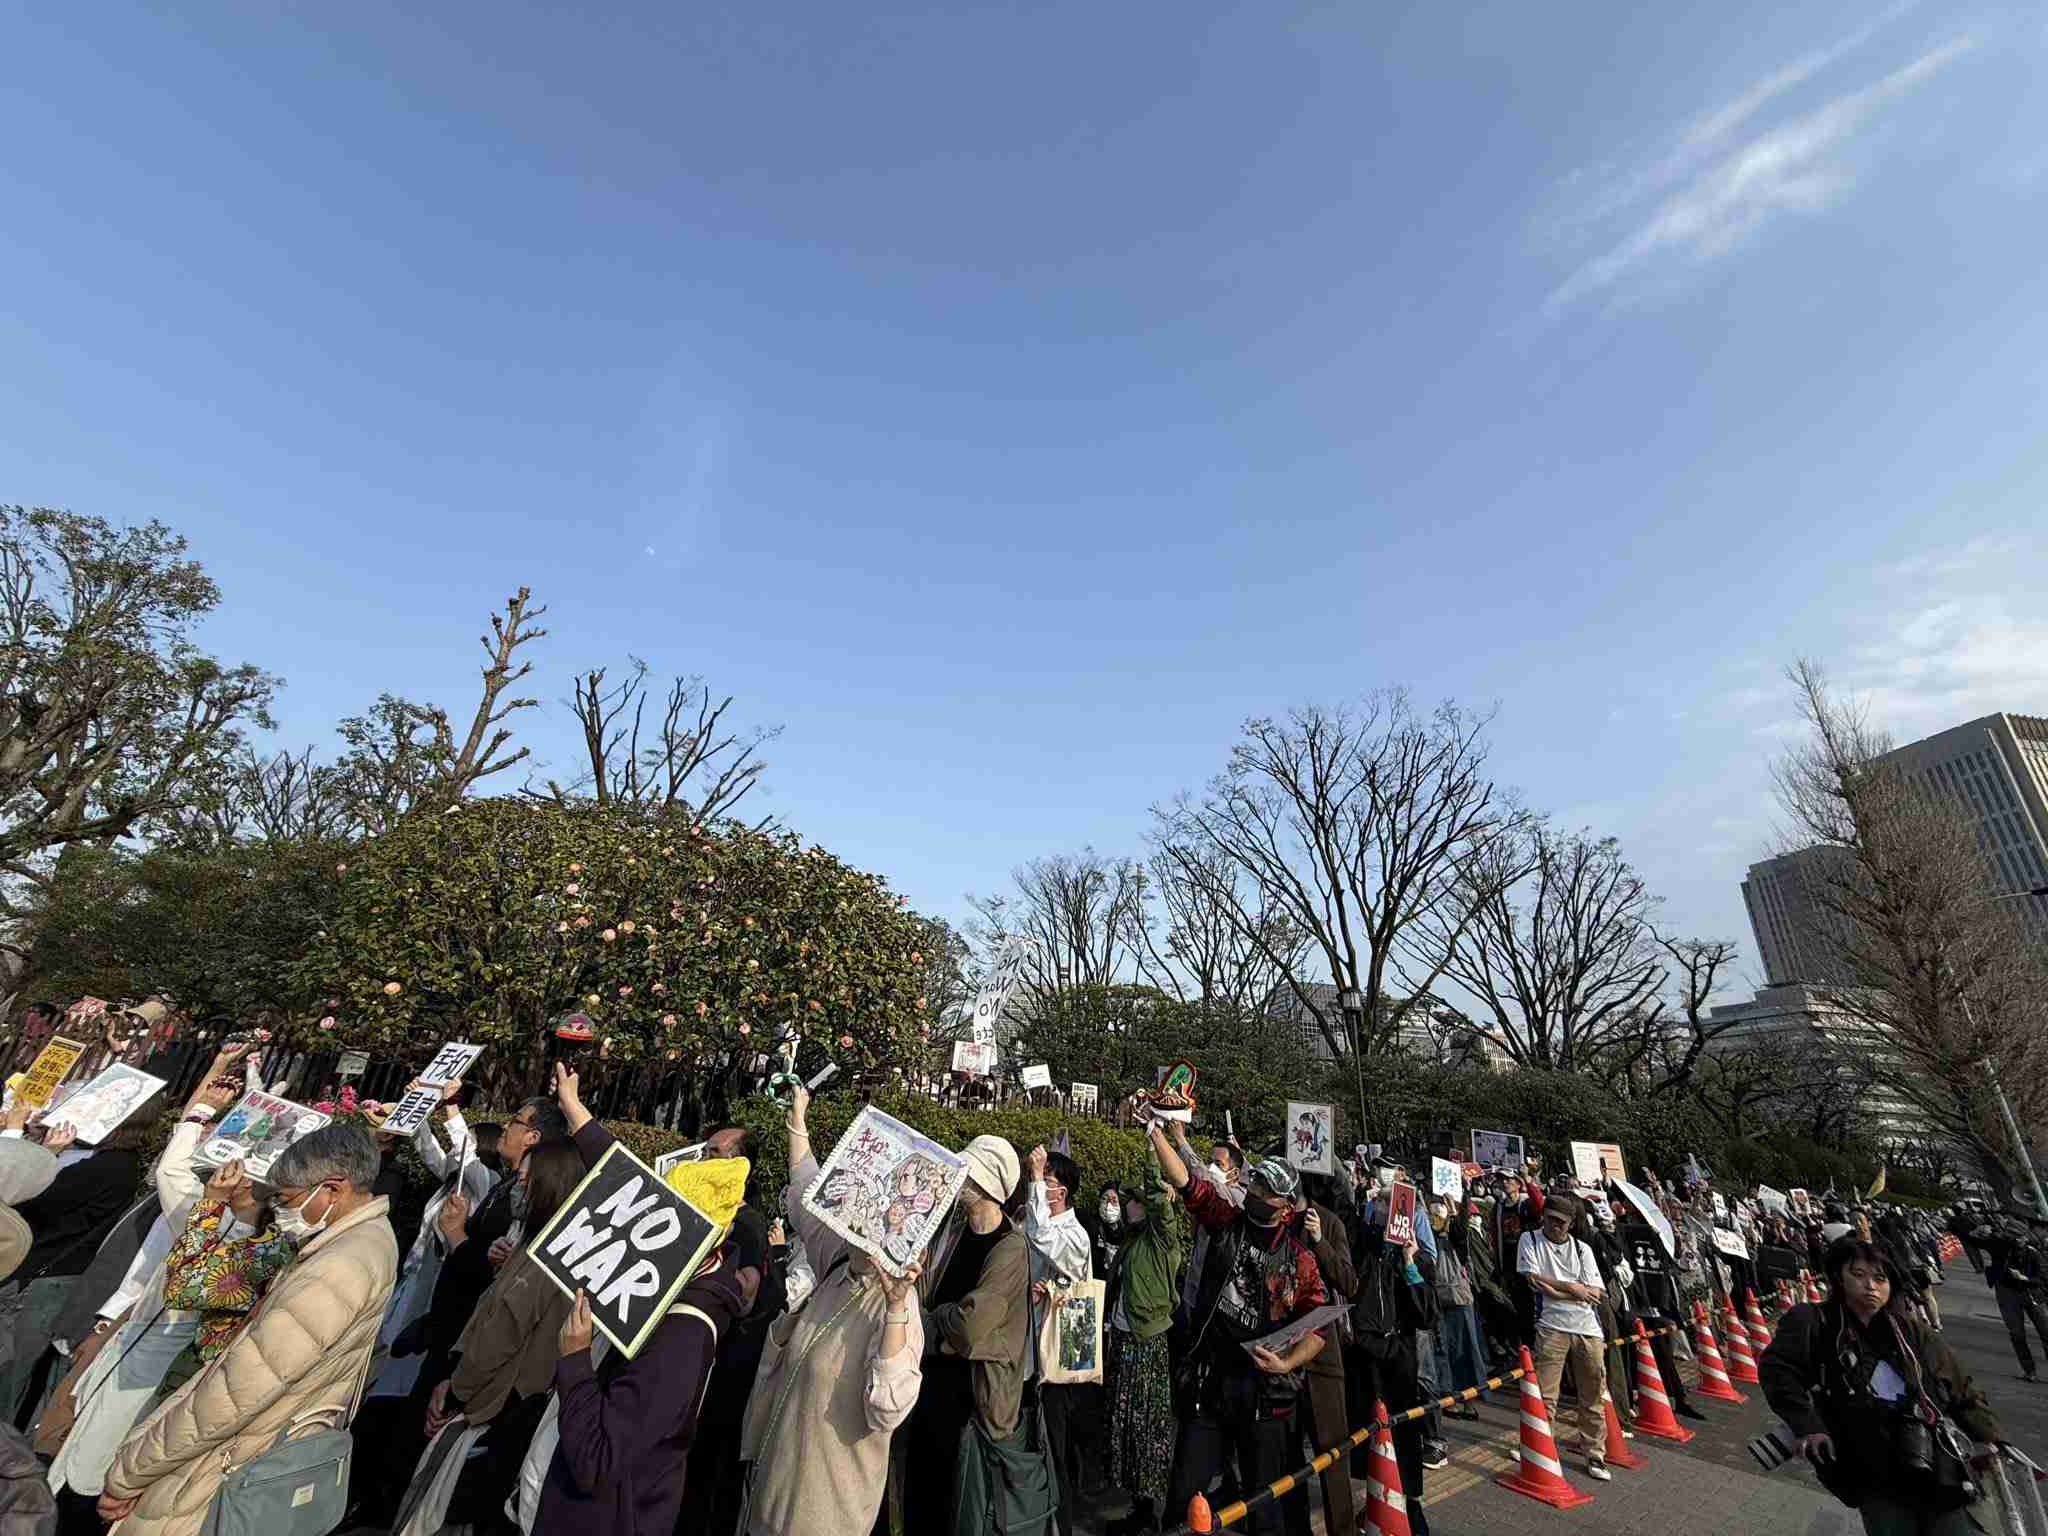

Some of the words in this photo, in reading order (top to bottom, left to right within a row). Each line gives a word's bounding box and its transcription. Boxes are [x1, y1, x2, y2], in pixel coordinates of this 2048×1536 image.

[594, 1175, 681, 1251] NO
[1394, 1213, 1410, 1228] NO
[546, 1206, 660, 1324] WAR
